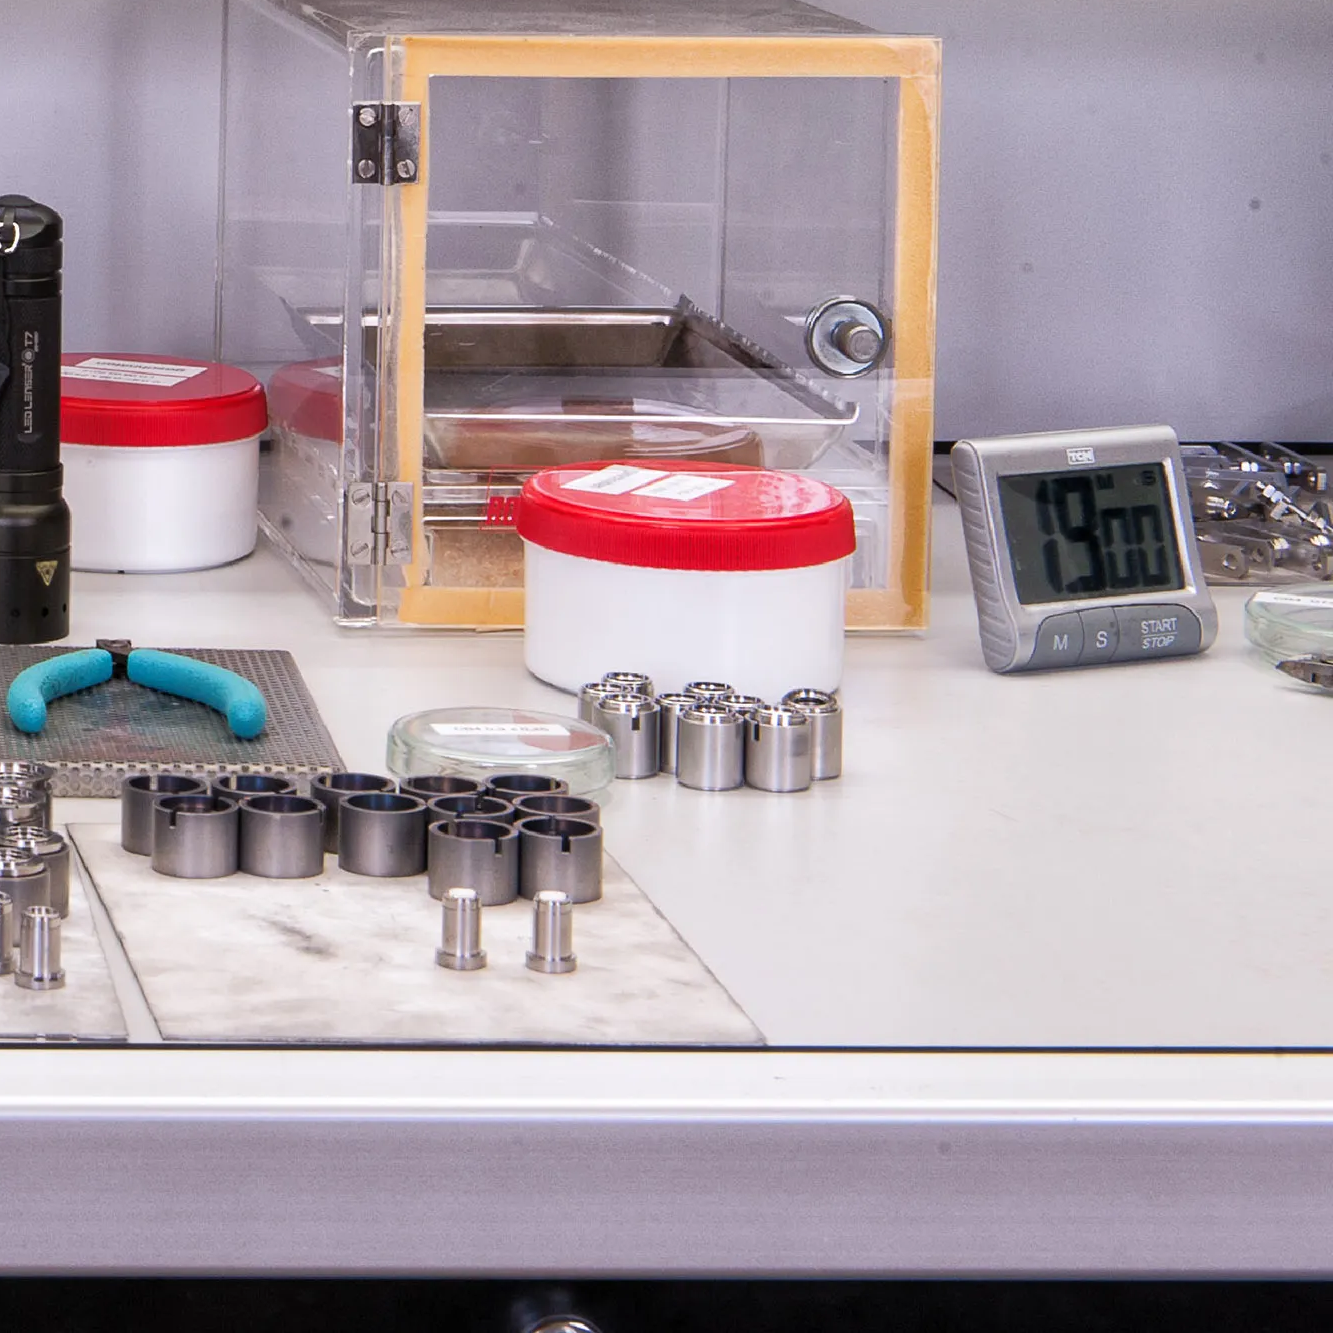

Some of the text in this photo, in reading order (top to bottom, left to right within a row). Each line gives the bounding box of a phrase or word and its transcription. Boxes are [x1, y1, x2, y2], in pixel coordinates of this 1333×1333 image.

[24, 411, 33, 433] LED
[1140, 617, 1178, 634] START
[1052, 631, 1175, 651] M S STOP
